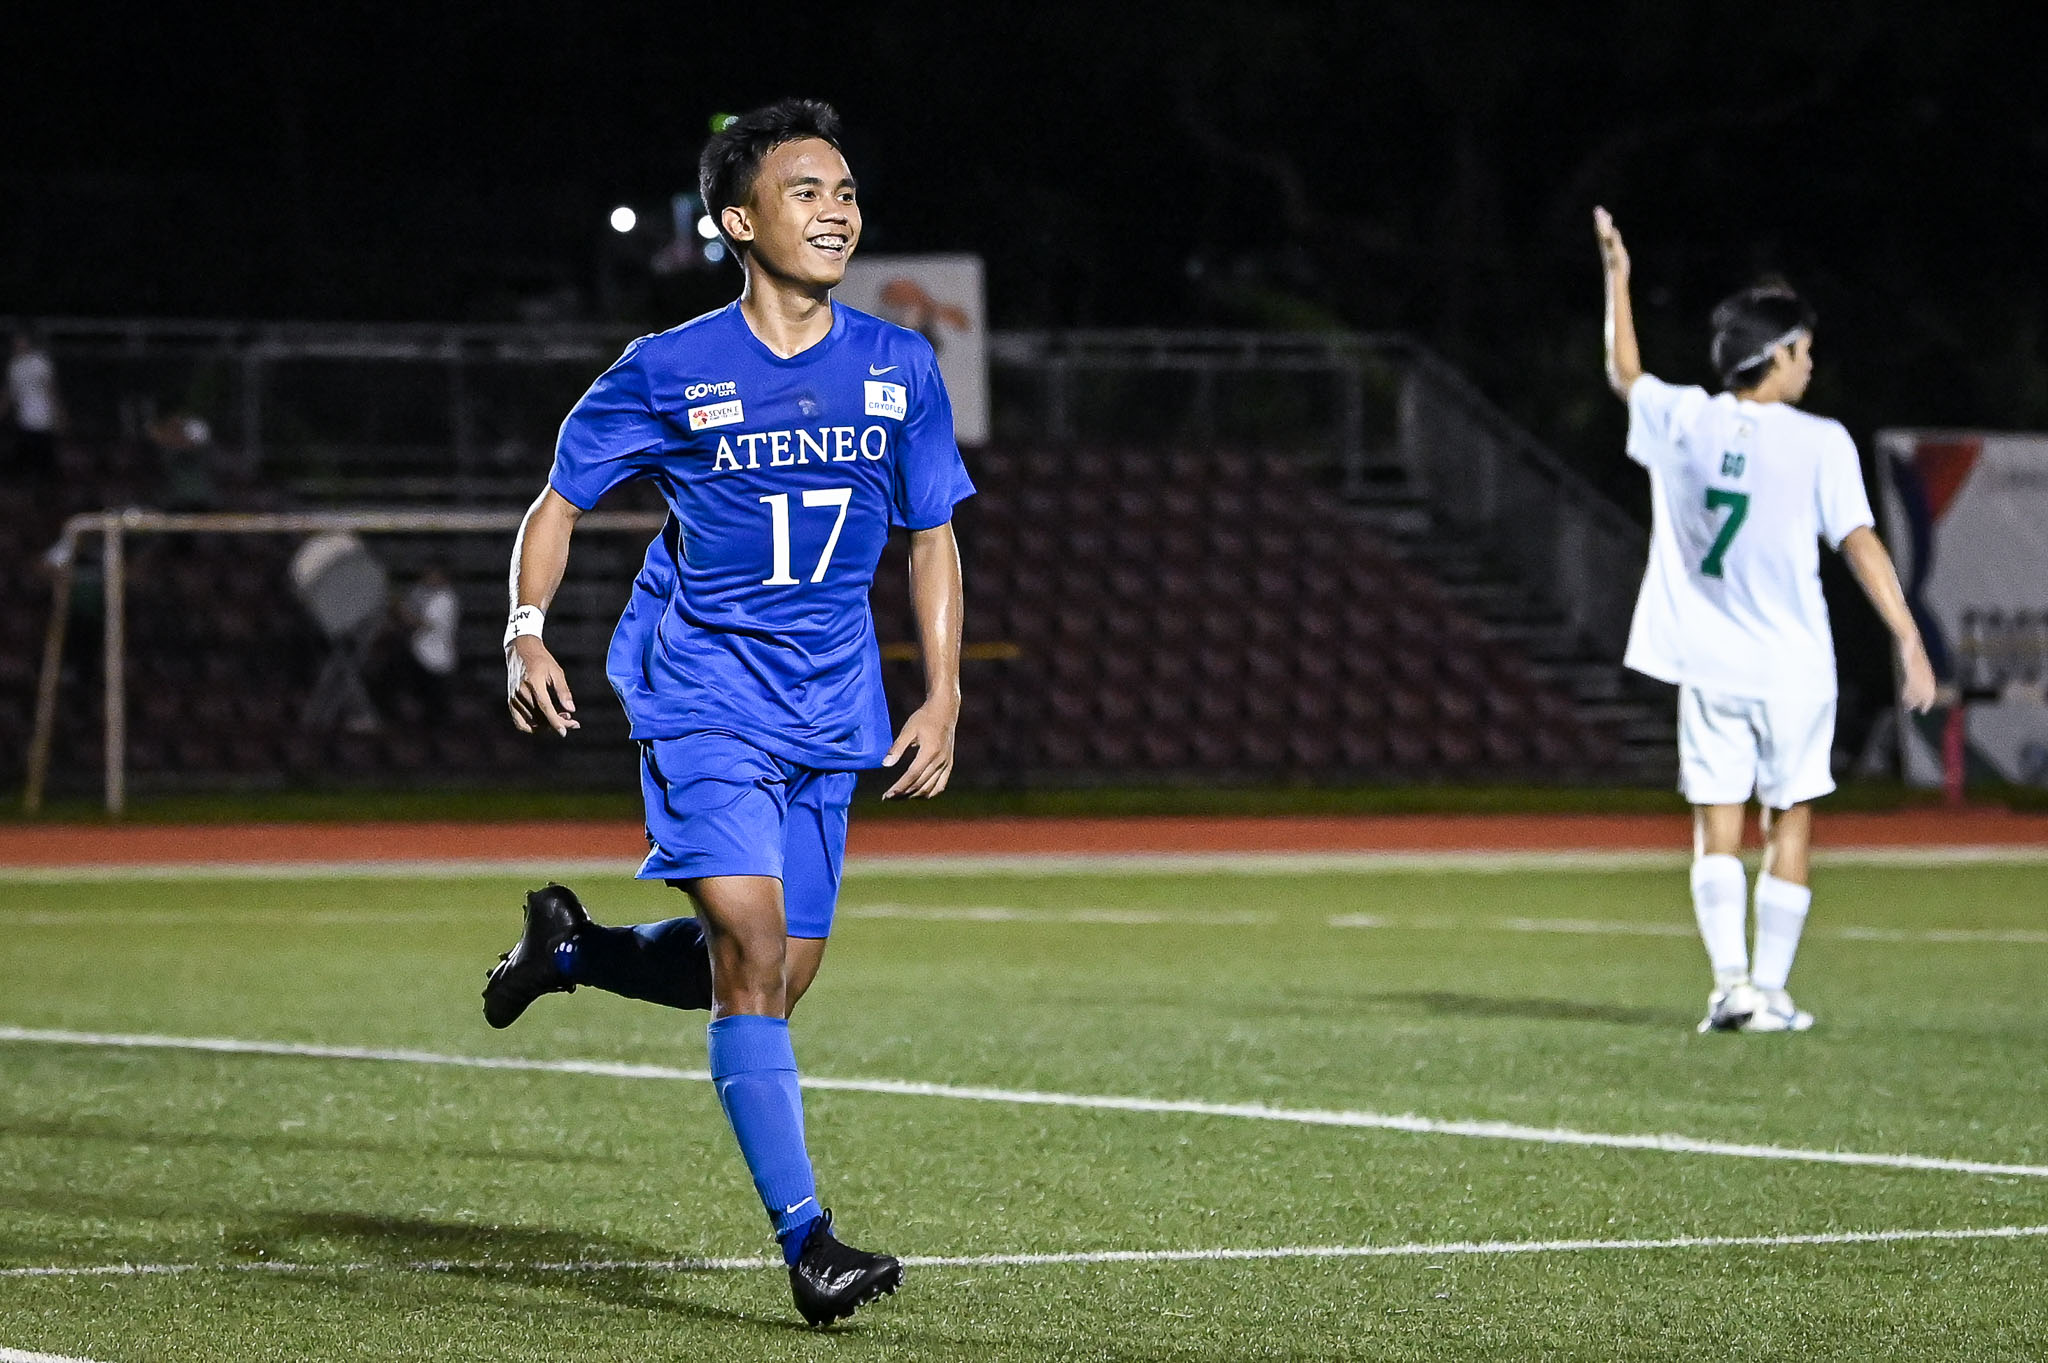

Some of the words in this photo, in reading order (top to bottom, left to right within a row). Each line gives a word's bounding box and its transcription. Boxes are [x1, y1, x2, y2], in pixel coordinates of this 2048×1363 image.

[709, 408, 732, 417] SEVEN
[712, 425, 888, 472] ATENEO
[759, 487, 853, 586] 17
[1702, 487, 1751, 578] 7
